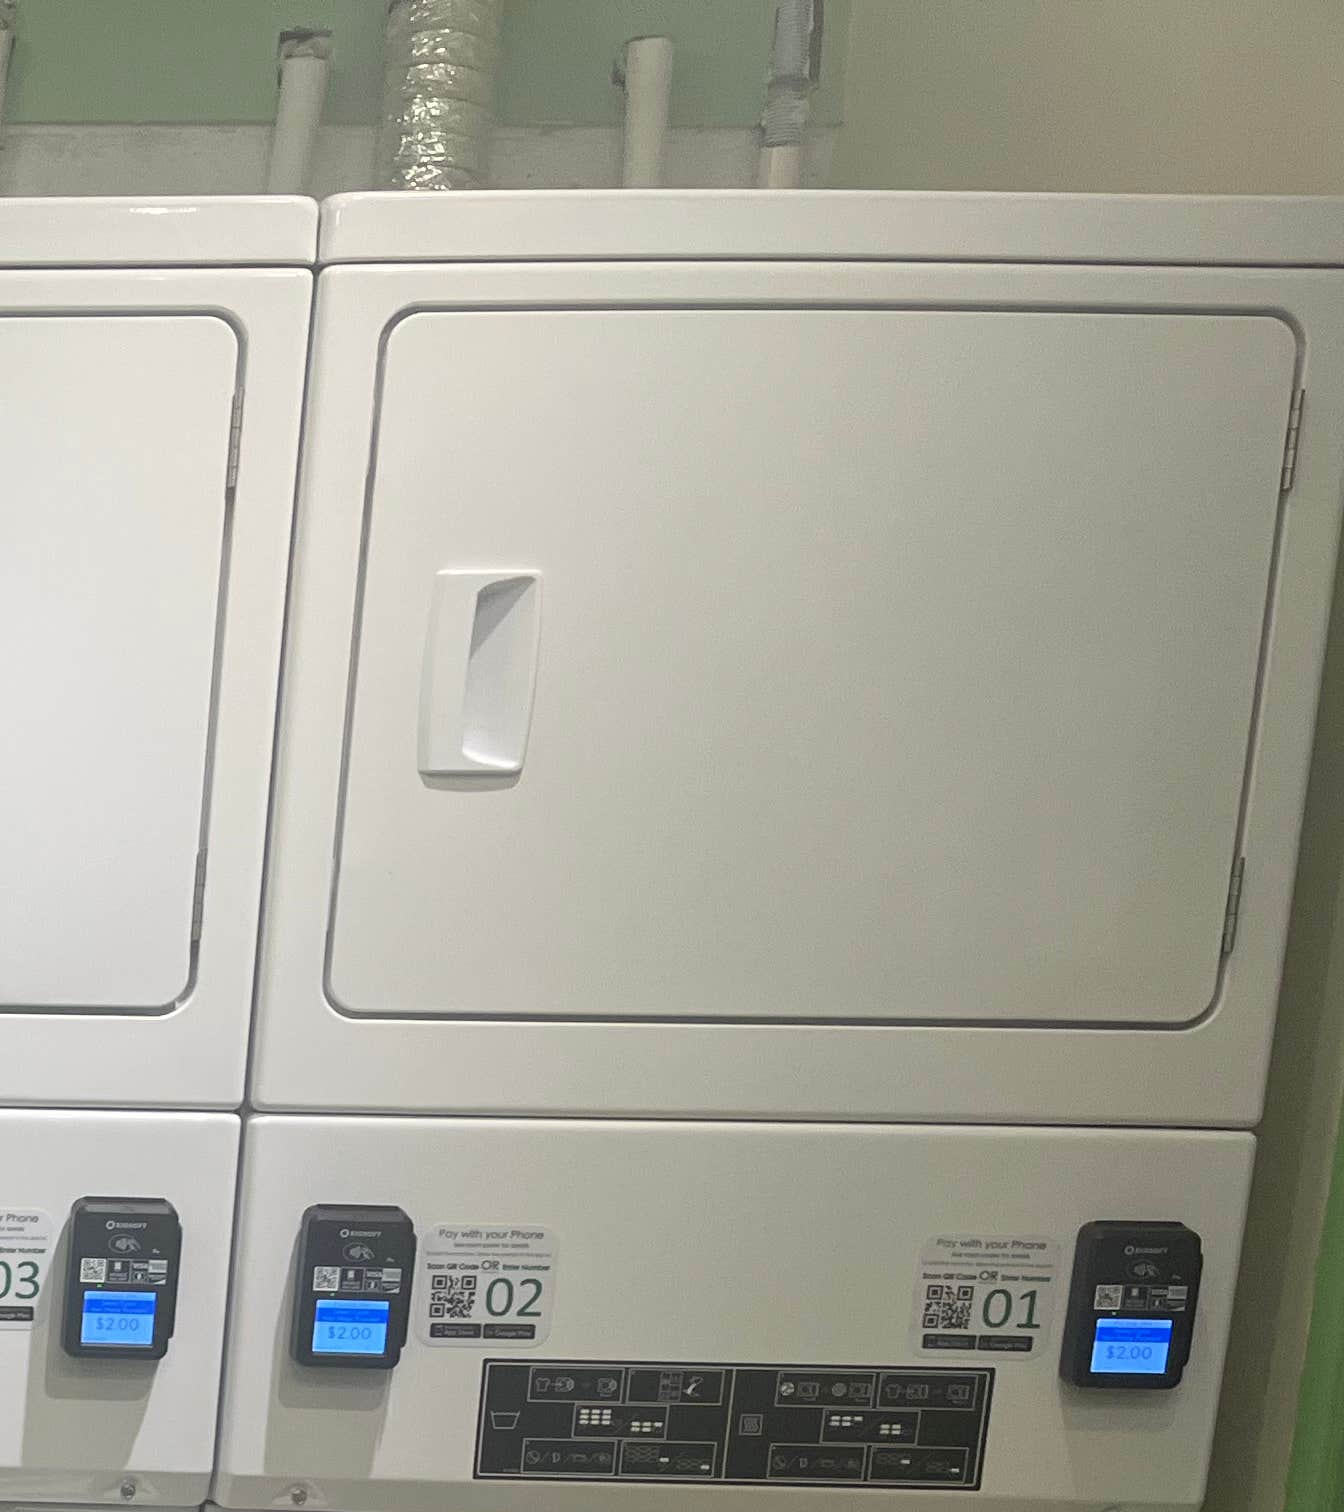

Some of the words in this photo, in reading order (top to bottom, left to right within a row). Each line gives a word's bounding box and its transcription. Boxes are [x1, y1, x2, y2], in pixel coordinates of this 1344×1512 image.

[6, 1214, 38, 1223] Phone
[439, 1229, 459, 1240] Pay
[461, 1230, 483, 1239] with
[485, 1231, 508, 1240] your
[510, 1230, 544, 1240] Phone
[960, 1239, 983, 1249] with
[984, 1241, 1009, 1250] your
[1012, 1239, 1047, 1250] Phone
[481, 1260, 500, 1271] OR
[979, 1270, 998, 1281] OR
[485, 1277, 543, 1317] 02
[982, 1288, 1040, 1329] 01
[96, 1318, 139, 1331] $2.00
[327, 1325, 372, 1340] $2.00
[1105, 1346, 1152, 1360] $2.00
